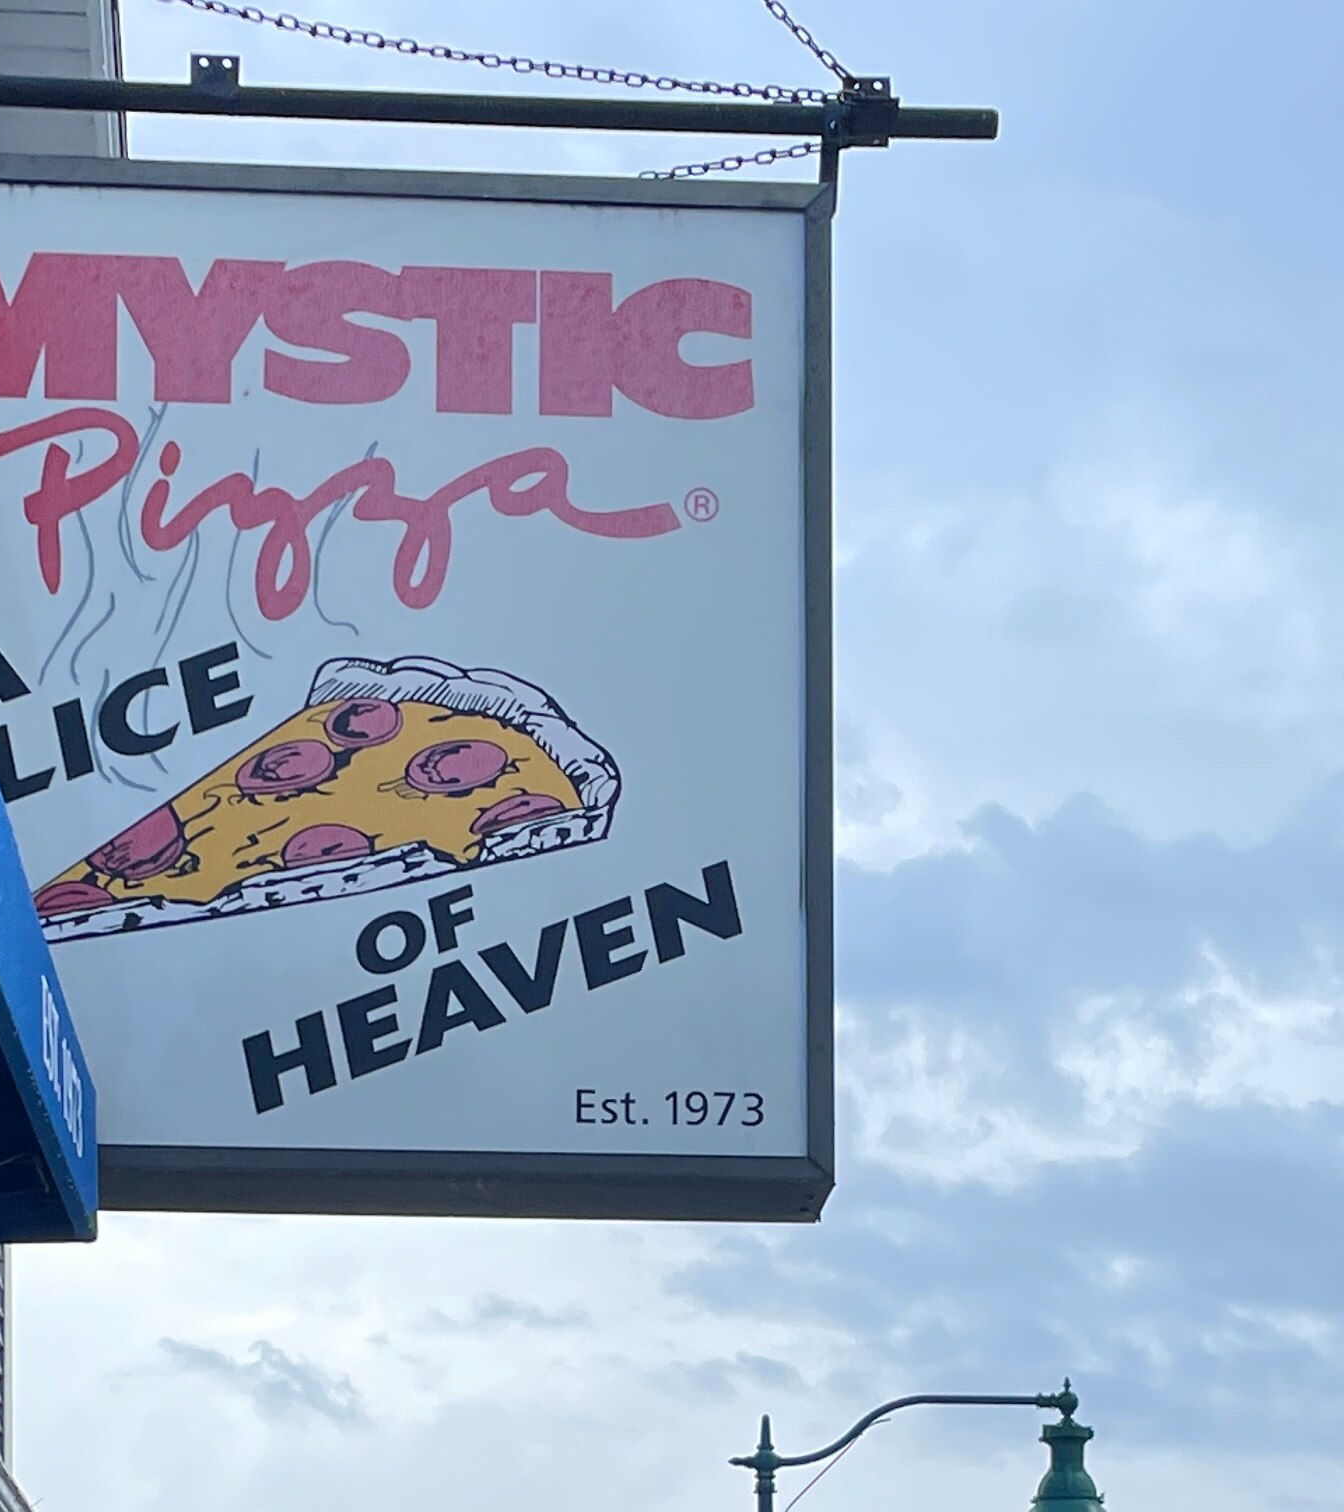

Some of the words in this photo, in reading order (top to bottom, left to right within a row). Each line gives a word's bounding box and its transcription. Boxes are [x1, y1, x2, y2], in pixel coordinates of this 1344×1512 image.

[353, 883, 477, 978] OF
[241, 861, 744, 1115] HEAVEN
[574, 1088, 648, 1128] Est.
[663, 1089, 765, 1130] 1973
